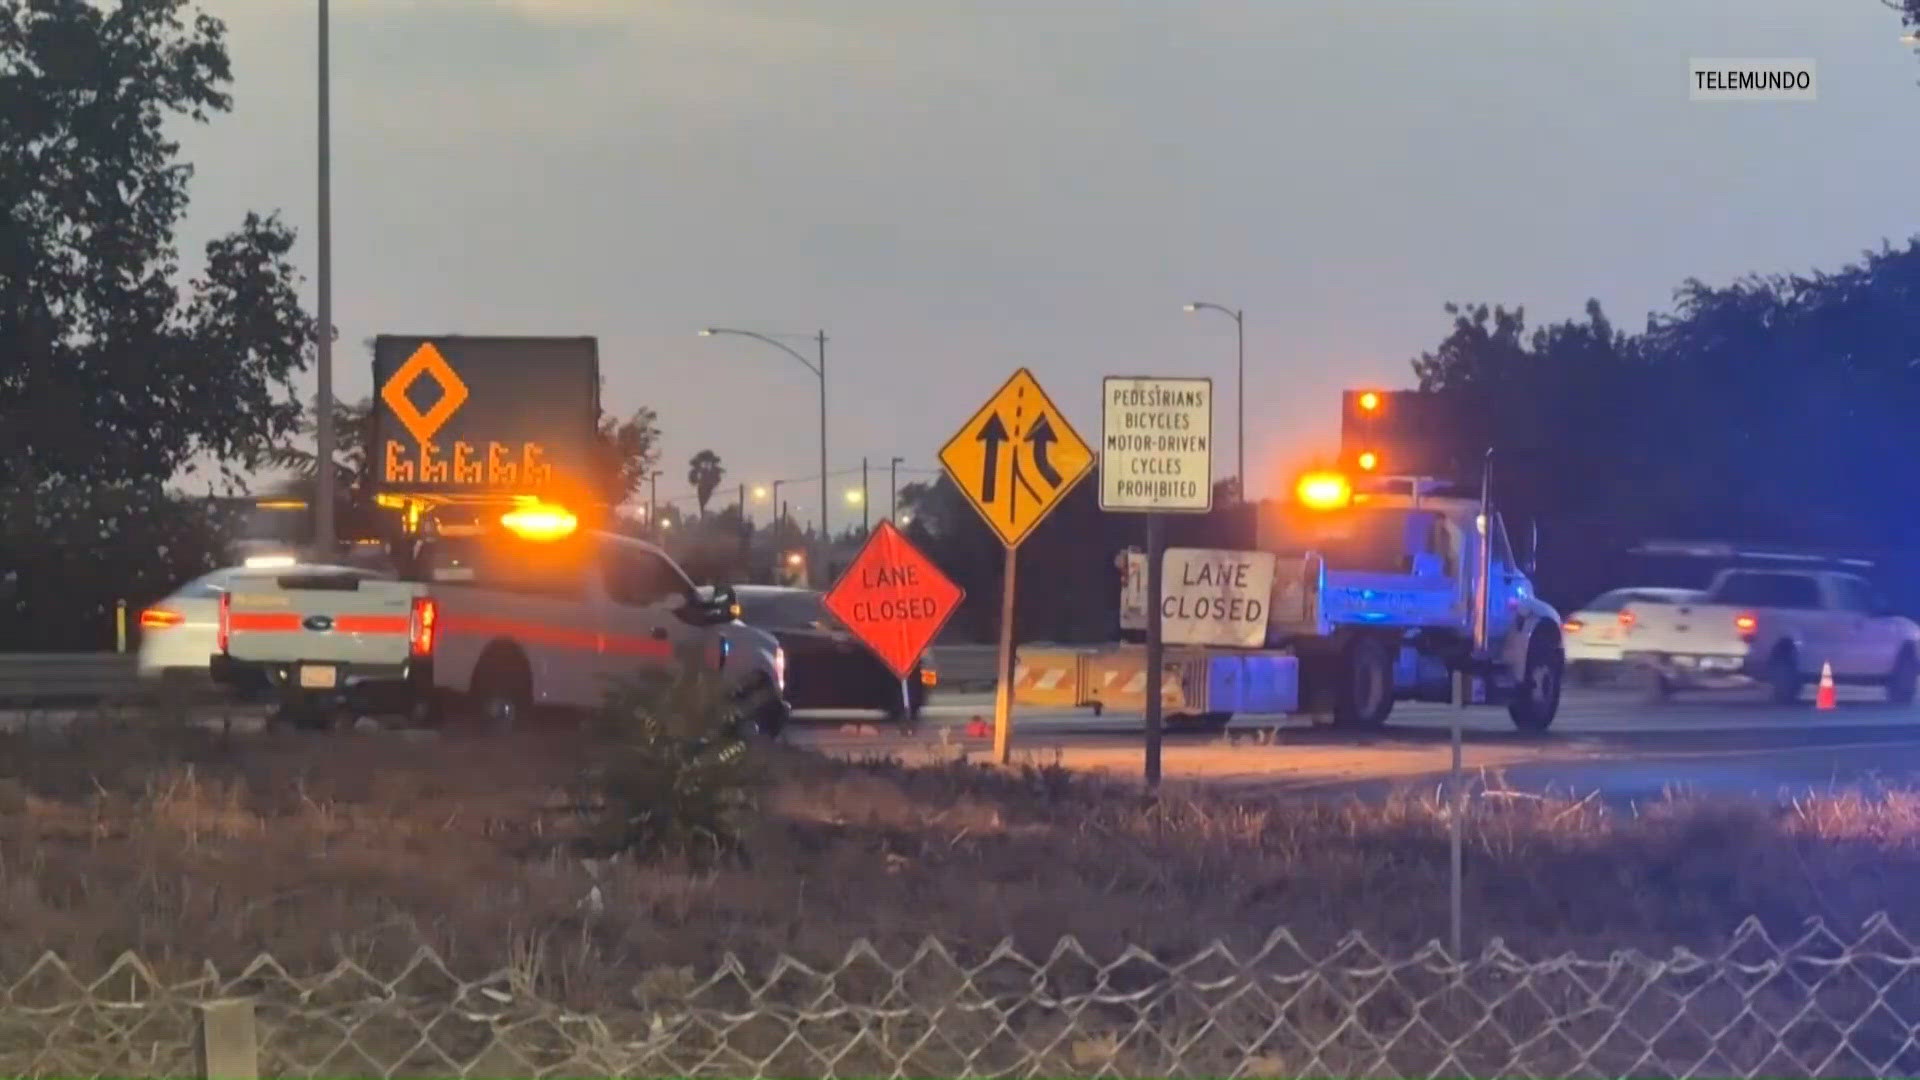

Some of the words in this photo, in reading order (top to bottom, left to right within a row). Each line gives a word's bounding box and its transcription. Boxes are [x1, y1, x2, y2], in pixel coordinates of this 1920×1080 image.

[1113, 389, 1203, 408] PEDESTRIANS
[1125, 412, 1190, 430] BICYCLES
[1107, 435, 1207, 452] MOTOR-DRIVEN
[1131, 458, 1182, 475] CYCLES
[1117, 481, 1197, 498] PROHIBITED
[862, 564, 919, 589] LANE
[1183, 561, 1250, 588] LANE
[853, 598, 936, 622] CLOSED
[1162, 595, 1262, 623] CLOSED
